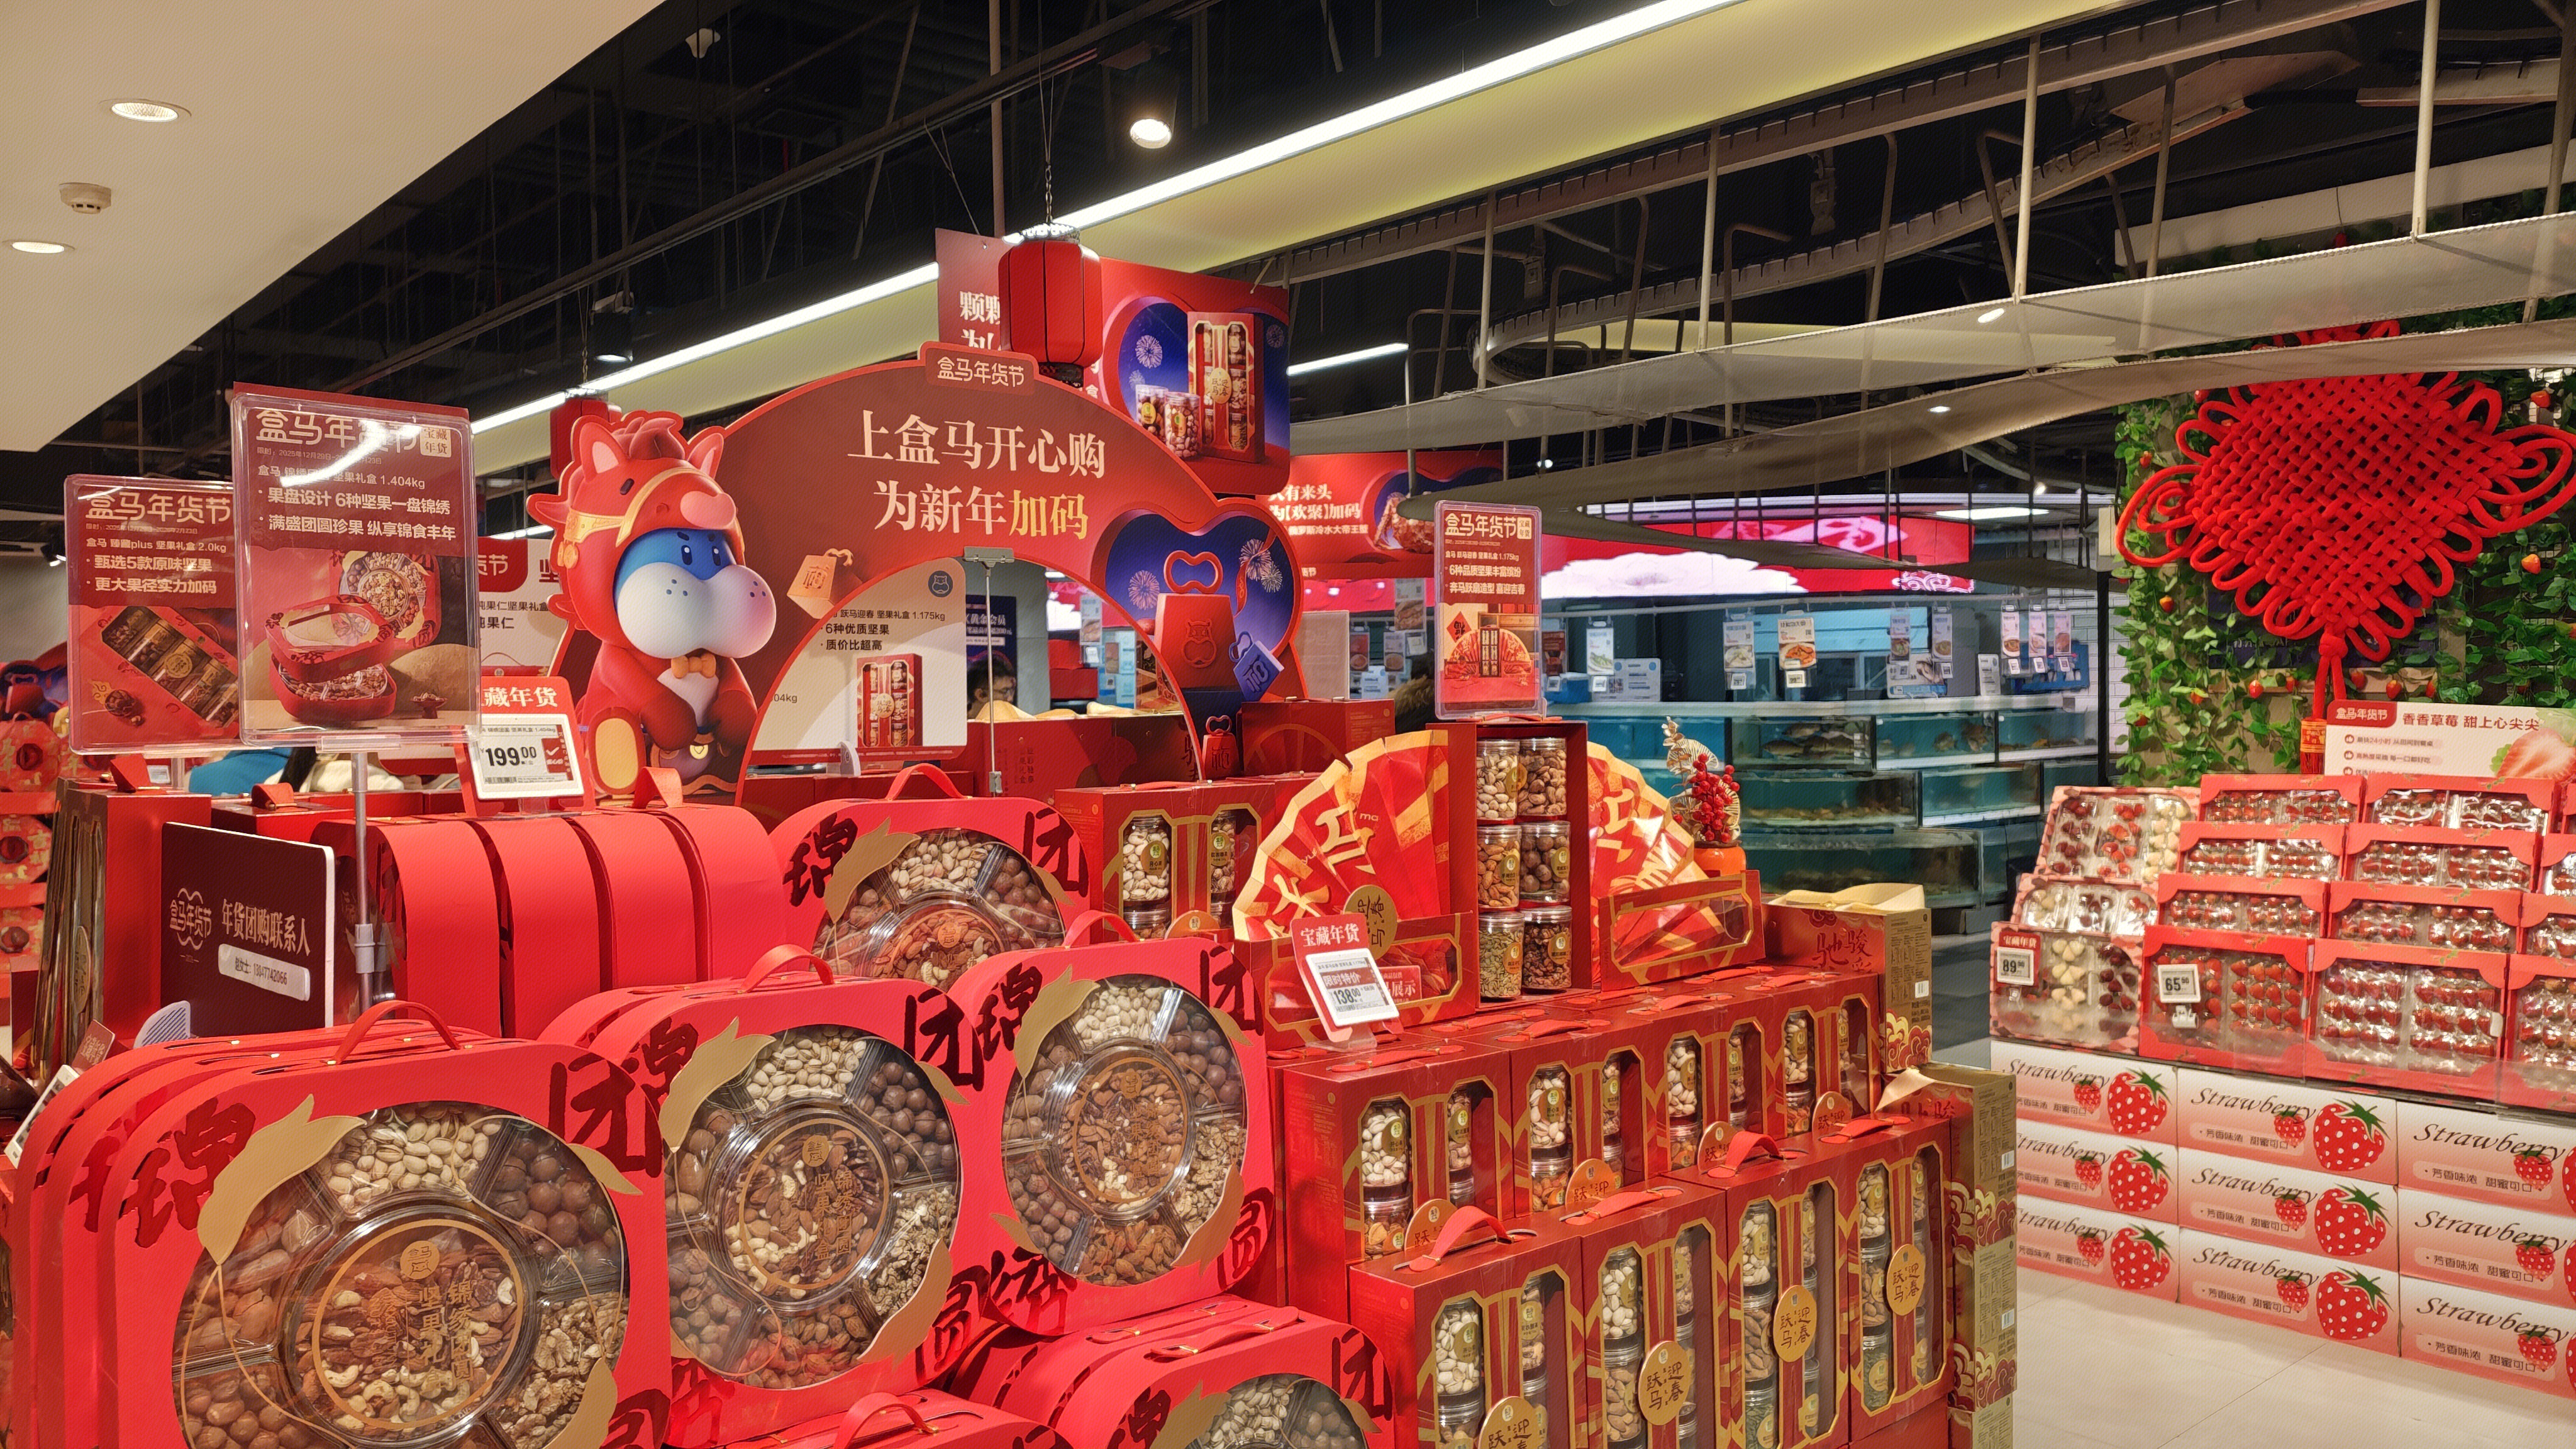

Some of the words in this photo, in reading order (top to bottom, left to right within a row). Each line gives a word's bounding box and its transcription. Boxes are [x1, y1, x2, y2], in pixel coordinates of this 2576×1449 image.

[937, 355, 1024, 388] 盒马年货节
[425, 442, 448, 455] 年货
[848, 409, 1105, 479] 上盒马开心购
[258, 464, 281, 477] 盒马
[380, 475, 425, 489] 1.404kg
[85, 491, 231, 525] 盒马年货节
[268, 487, 331, 506] 果盘设计
[335, 492, 450, 515] 6种坚果一盘锦绣
[873, 480, 1089, 540] 为新年加码
[269, 514, 364, 535] 满盛团圆珍果
[367, 520, 456, 541] 纵享锦食丰年
[1445, 513, 1517, 538] 盒马年货节
[86, 538, 107, 548] 盒马
[156, 541, 196, 552] 坚果礼盒
[198, 543, 226, 553] 2.0kg
[1499, 553, 1519, 562] 1.175kg
[94, 555, 213, 572] 甄选5款原味坚果
[95, 577, 217, 594] 更大果径实力加码
[826, 623, 890, 635] 6种优质坚果
[840, 609, 874, 618] 跃马迎春
[877, 610, 910, 619] 坚果礼盒
[913, 611, 945, 621] 1.175kg
[826, 640, 882, 650] 质价比超高
[482, 686, 558, 708] 藏年货
[2336, 707, 2388, 721] 盒马年货节
[2403, 713, 2458, 727] 香香草莓
[2463, 716, 2540, 731] 甜上心尖尖
[1360, 813, 1379, 821] ma
[1024, 808, 1089, 897] 团
[169, 899, 212, 938] 盒马年货节
[222, 898, 311, 957] 年货团购联系人
[1300, 923, 1360, 948] 宝藏年货
[1199, 946, 1263, 1035] 团
[1322, 972, 1361, 987] 限时特价
[904, 991, 985, 1092] 团
[2010, 1058, 2111, 1089] Strawberry
[549, 1052, 663, 1178] 团
[2190, 1087, 2317, 1124] Strawberry
[2206, 1128, 2243, 1143] 芳香味浓
[2413, 1123, 2566, 1165] Strawberry
[2192, 1167, 2318, 1207] Strawberry
[2432, 1168, 2477, 1184] 芳香味浓
[2485, 1177, 2532, 1192] 甜蜜可口
[2414, 1211, 2568, 1255] Strawberry
[408, 1245, 432, 1258] 盒马
[2192, 1248, 2319, 1289] Strawberry
[2433, 1255, 2479, 1273] 芳香味浓
[2487, 1265, 2534, 1282] 甜蜜可口
[447, 1279, 474, 1381] 锦绣团圆
[1779, 1313, 1794, 1350] 跃马
[1796, 1306, 1812, 1344] 迎春
[2417, 1297, 2569, 1346] Strawberry
[2435, 1341, 2481, 1361] 芳香味浓
[2489, 1353, 2536, 1372] 甜蜜可口
[1331, 1328, 1394, 1421] 团
[1646, 1371, 1663, 1410] 跃马
[1667, 1361, 1684, 1402] 迎春
